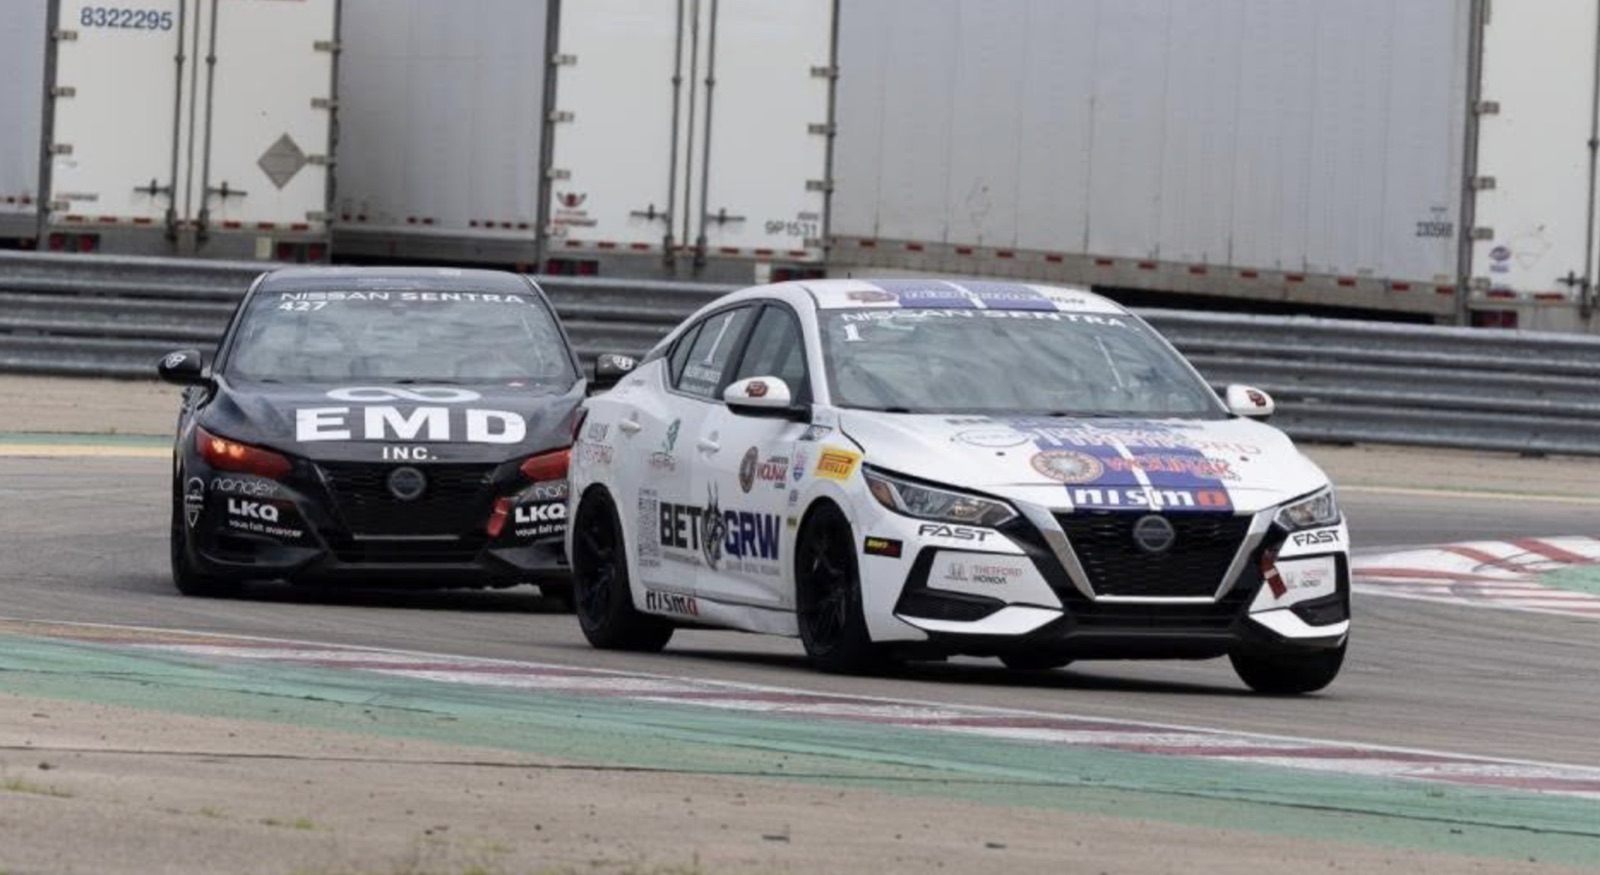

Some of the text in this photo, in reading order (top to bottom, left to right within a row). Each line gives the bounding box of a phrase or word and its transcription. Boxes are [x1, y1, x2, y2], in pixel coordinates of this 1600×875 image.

[80, 6, 173, 31] 8322295
[278, 301, 328, 312] 427
[280, 291, 525, 304] NISSAN SENTRA
[296, 405, 527, 445] EMD
[382, 446, 438, 460] INC.
[228, 498, 279, 523] LKQ
[515, 502, 568, 524] LKQ
[659, 501, 701, 551] BET
[725, 508, 781, 561] GRW
[918, 524, 995, 542] FAST
[1293, 530, 1340, 547] FAST
